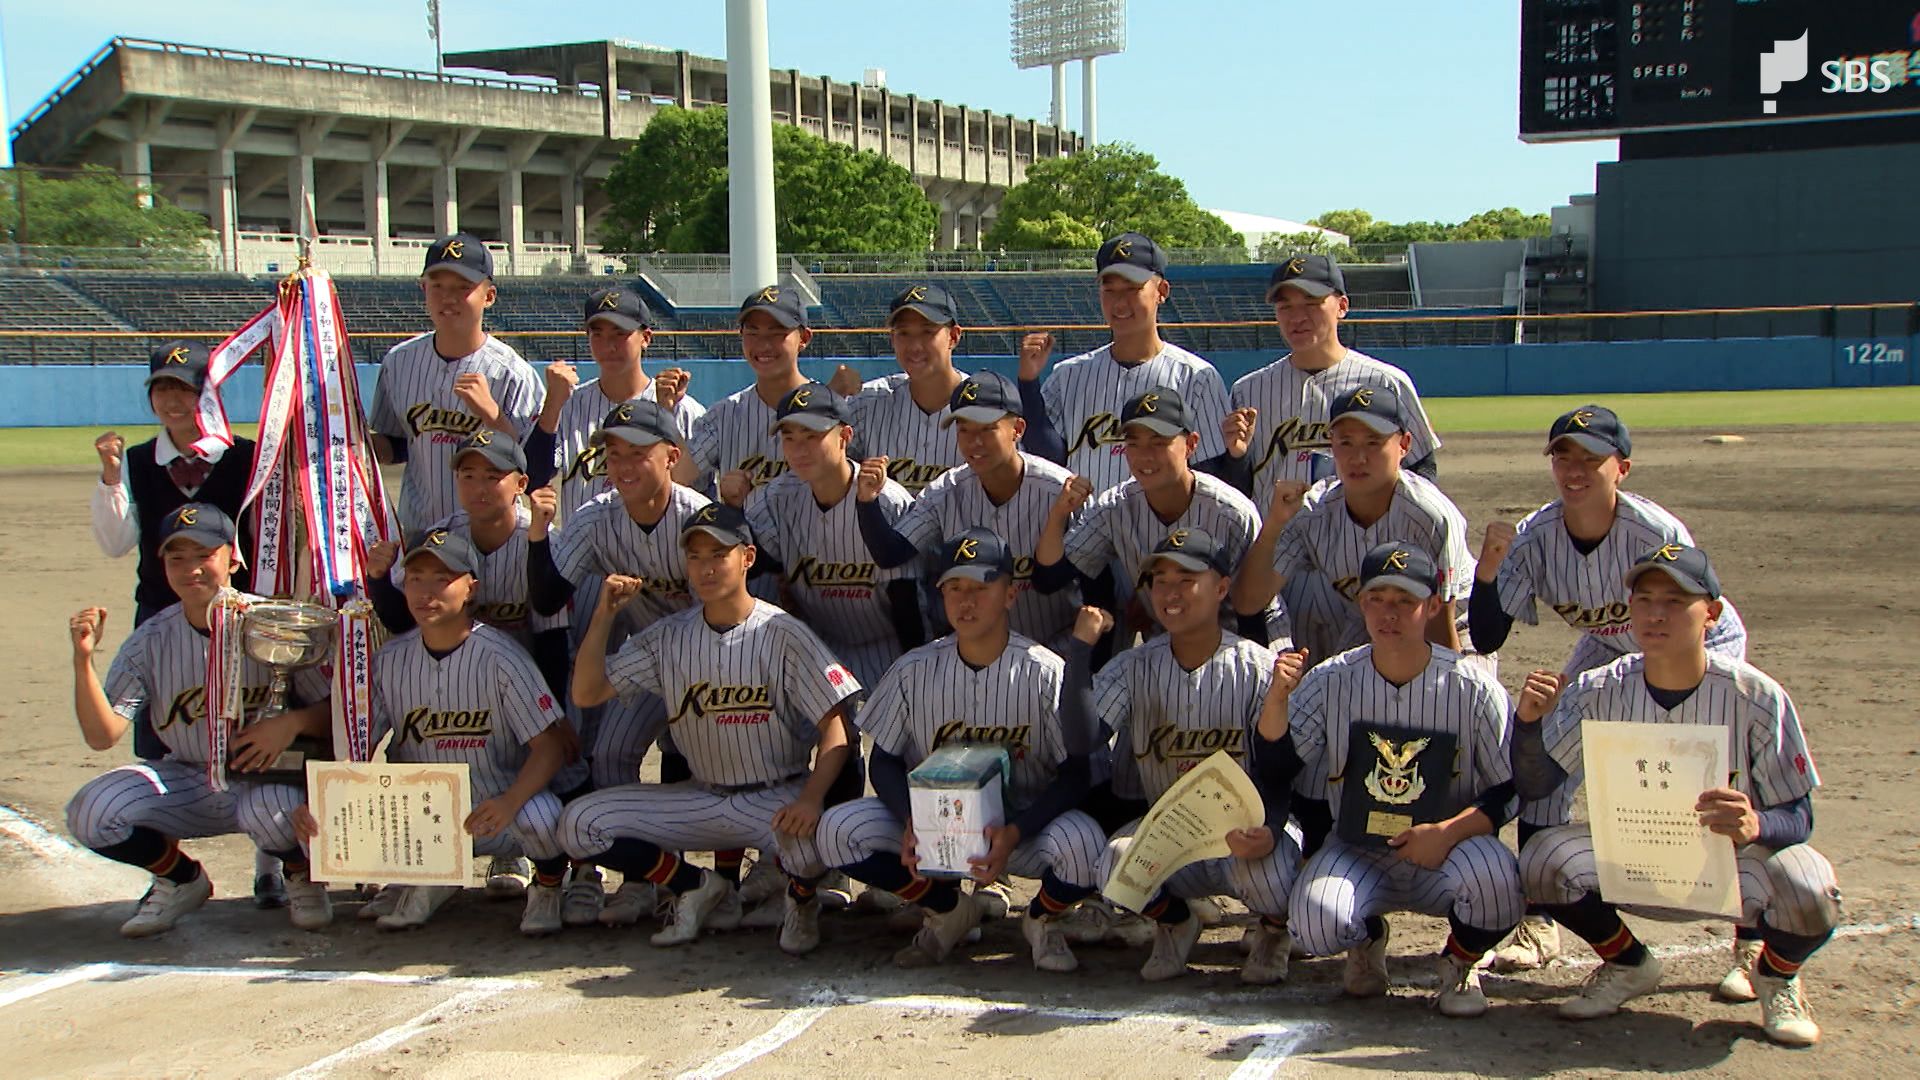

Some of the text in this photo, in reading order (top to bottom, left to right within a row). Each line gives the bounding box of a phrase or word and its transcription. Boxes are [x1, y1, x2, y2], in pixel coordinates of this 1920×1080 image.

[1632, 63, 1689, 79] SPEED
[1843, 343, 1904, 364] 122m
[790, 556, 877, 588] KATOH
[668, 682, 772, 722] KATOH
[398, 707, 493, 745] KATOH
[716, 712, 769, 725] GAKUEN
[436, 737, 487, 750] GAKUEN
[1136, 724, 1244, 764] KATOH
[1635, 759, 1673, 774] 賞状
